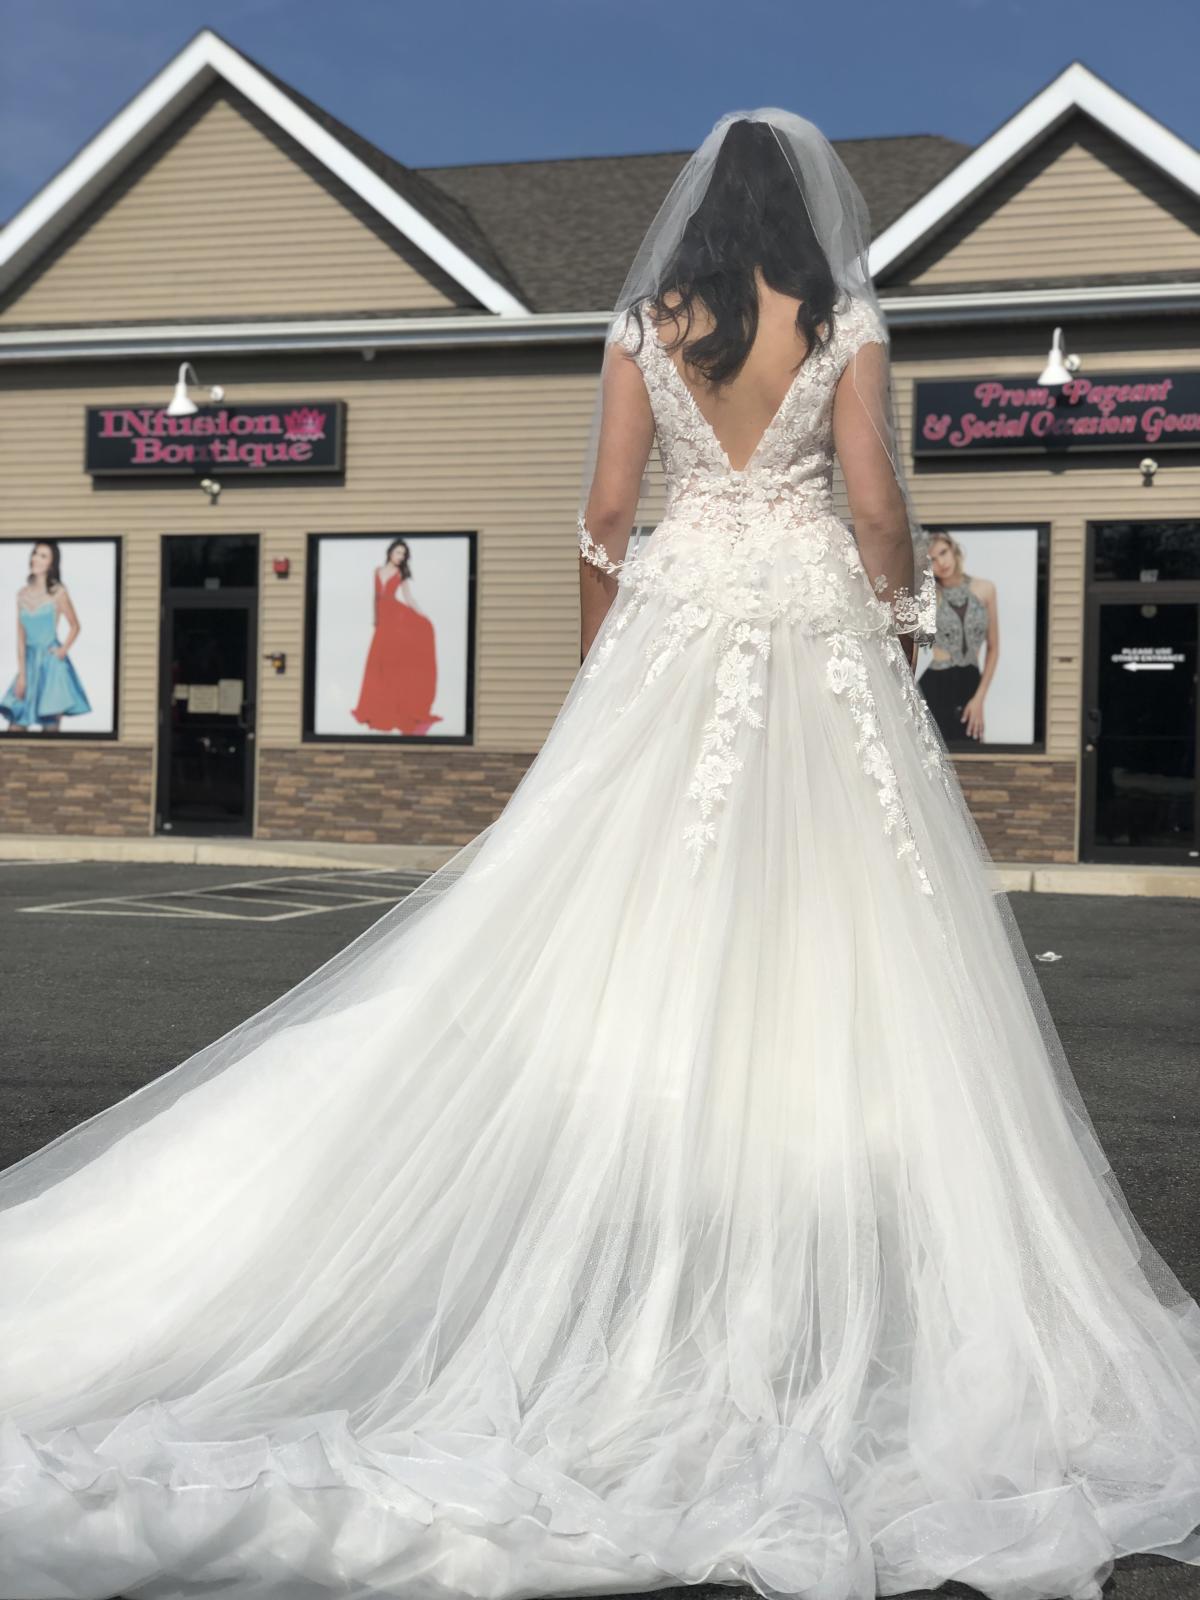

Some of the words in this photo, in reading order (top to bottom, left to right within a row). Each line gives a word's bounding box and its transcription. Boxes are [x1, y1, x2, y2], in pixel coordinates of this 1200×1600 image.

[975, 383, 1056, 408] Prom,
[1063, 378, 1173, 412] Pageant
[922, 414, 951, 441] &
[949, 411, 1030, 447] Social
[1141, 407, 1200, 442] Gow
[131, 438, 312, 467] Boutique
